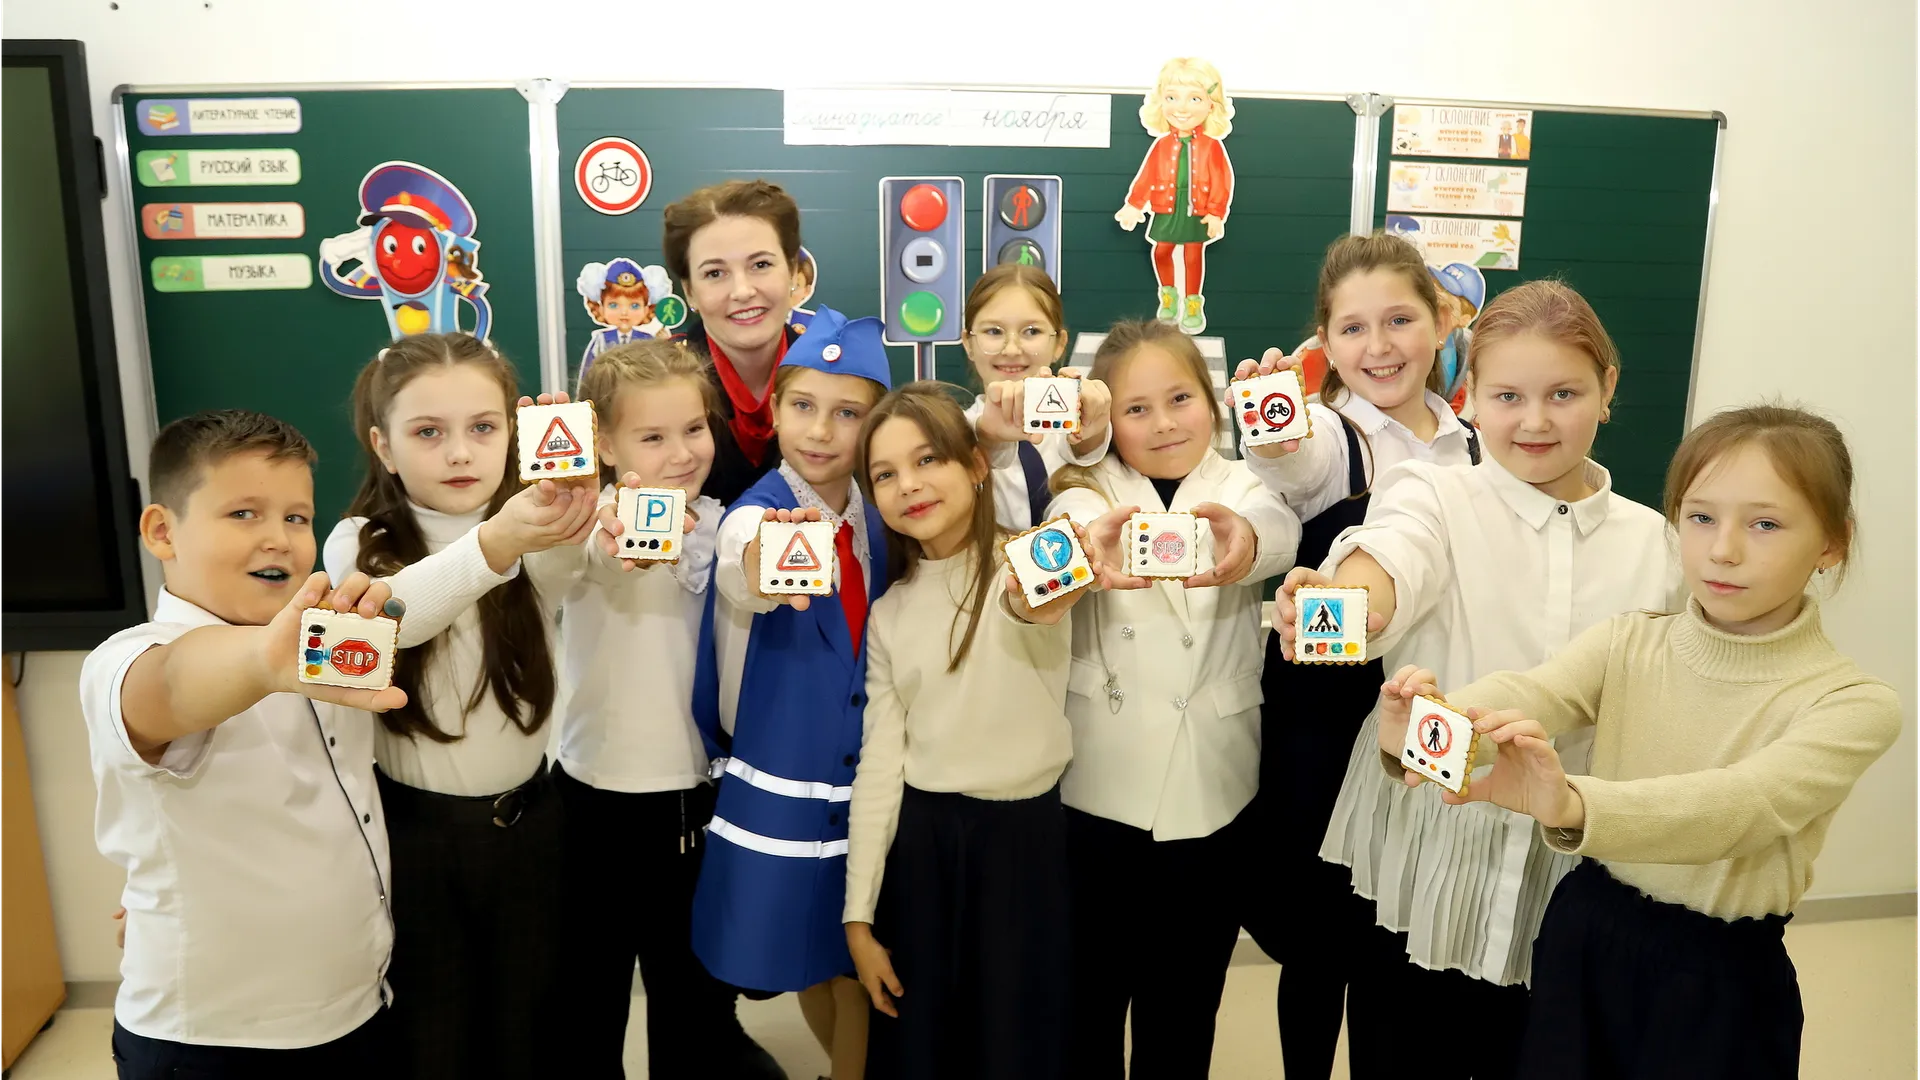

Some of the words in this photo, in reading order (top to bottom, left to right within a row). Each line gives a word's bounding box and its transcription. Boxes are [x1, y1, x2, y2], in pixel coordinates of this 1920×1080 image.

[192, 108, 260, 120] ЛИТЕРАТУРНОЕ
[264, 108, 297, 120] ЧТЕНИЕ
[983, 95, 1088, 142] ноября
[1440, 109, 1492, 127] СКЛОНЕНИЕ
[200, 157, 252, 173] РУССКИЙ
[259, 159, 288, 173] ЯЗЫК
[1425, 166, 1431, 181] 2
[1435, 166, 1487, 184] СКЛОНЕНИЕ
[207, 213, 288, 227] МАТЕМАТИКА
[1421, 220, 1427, 234] 3
[1431, 220, 1481, 237] СКЛОНЕНИЕ
[229, 265, 277, 279] МУЗЫКА
[646, 499, 667, 527] P
[1156, 541, 1184, 554] STOP
[335, 649, 374, 666] STOP
